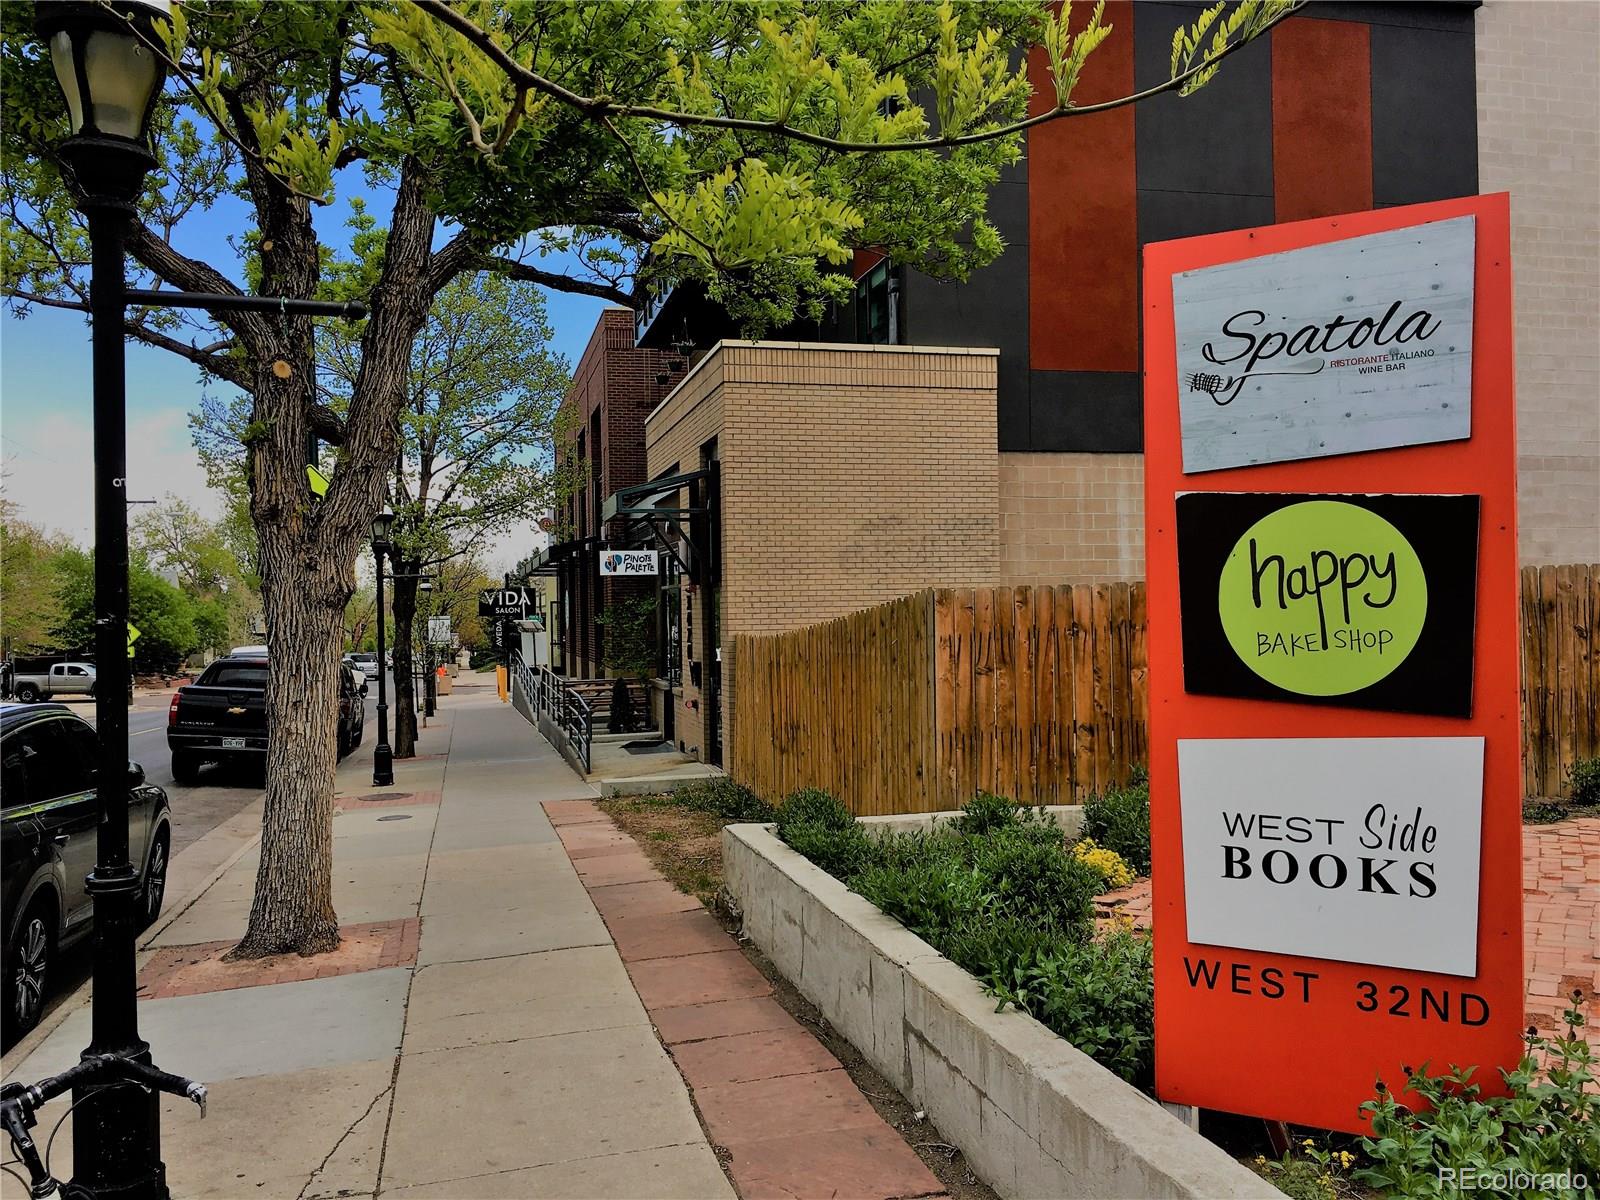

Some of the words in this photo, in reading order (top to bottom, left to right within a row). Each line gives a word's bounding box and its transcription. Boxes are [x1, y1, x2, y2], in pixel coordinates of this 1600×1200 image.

[1202, 300, 1442, 405] Spatola
[1330, 354, 1389, 368] RISTORANTE
[1391, 348, 1435, 361] ITALIANO
[1358, 365, 1383, 374] WINE
[1385, 363, 1406, 372] BAR
[624, 562, 655, 573] PALETTE
[484, 591, 531, 606] VIDA
[1249, 538, 1397, 650] happy
[495, 620, 503, 647] AVEDA
[1257, 632, 1320, 656] BAKE
[1334, 629, 1393, 654] SHOP
[1222, 811, 1344, 845] WEST
[1359, 803, 1437, 853] Side
[1220, 845, 1437, 898] BOOKS
[1183, 956, 1319, 1003] WEST
[1355, 980, 1490, 1026] 32ND
